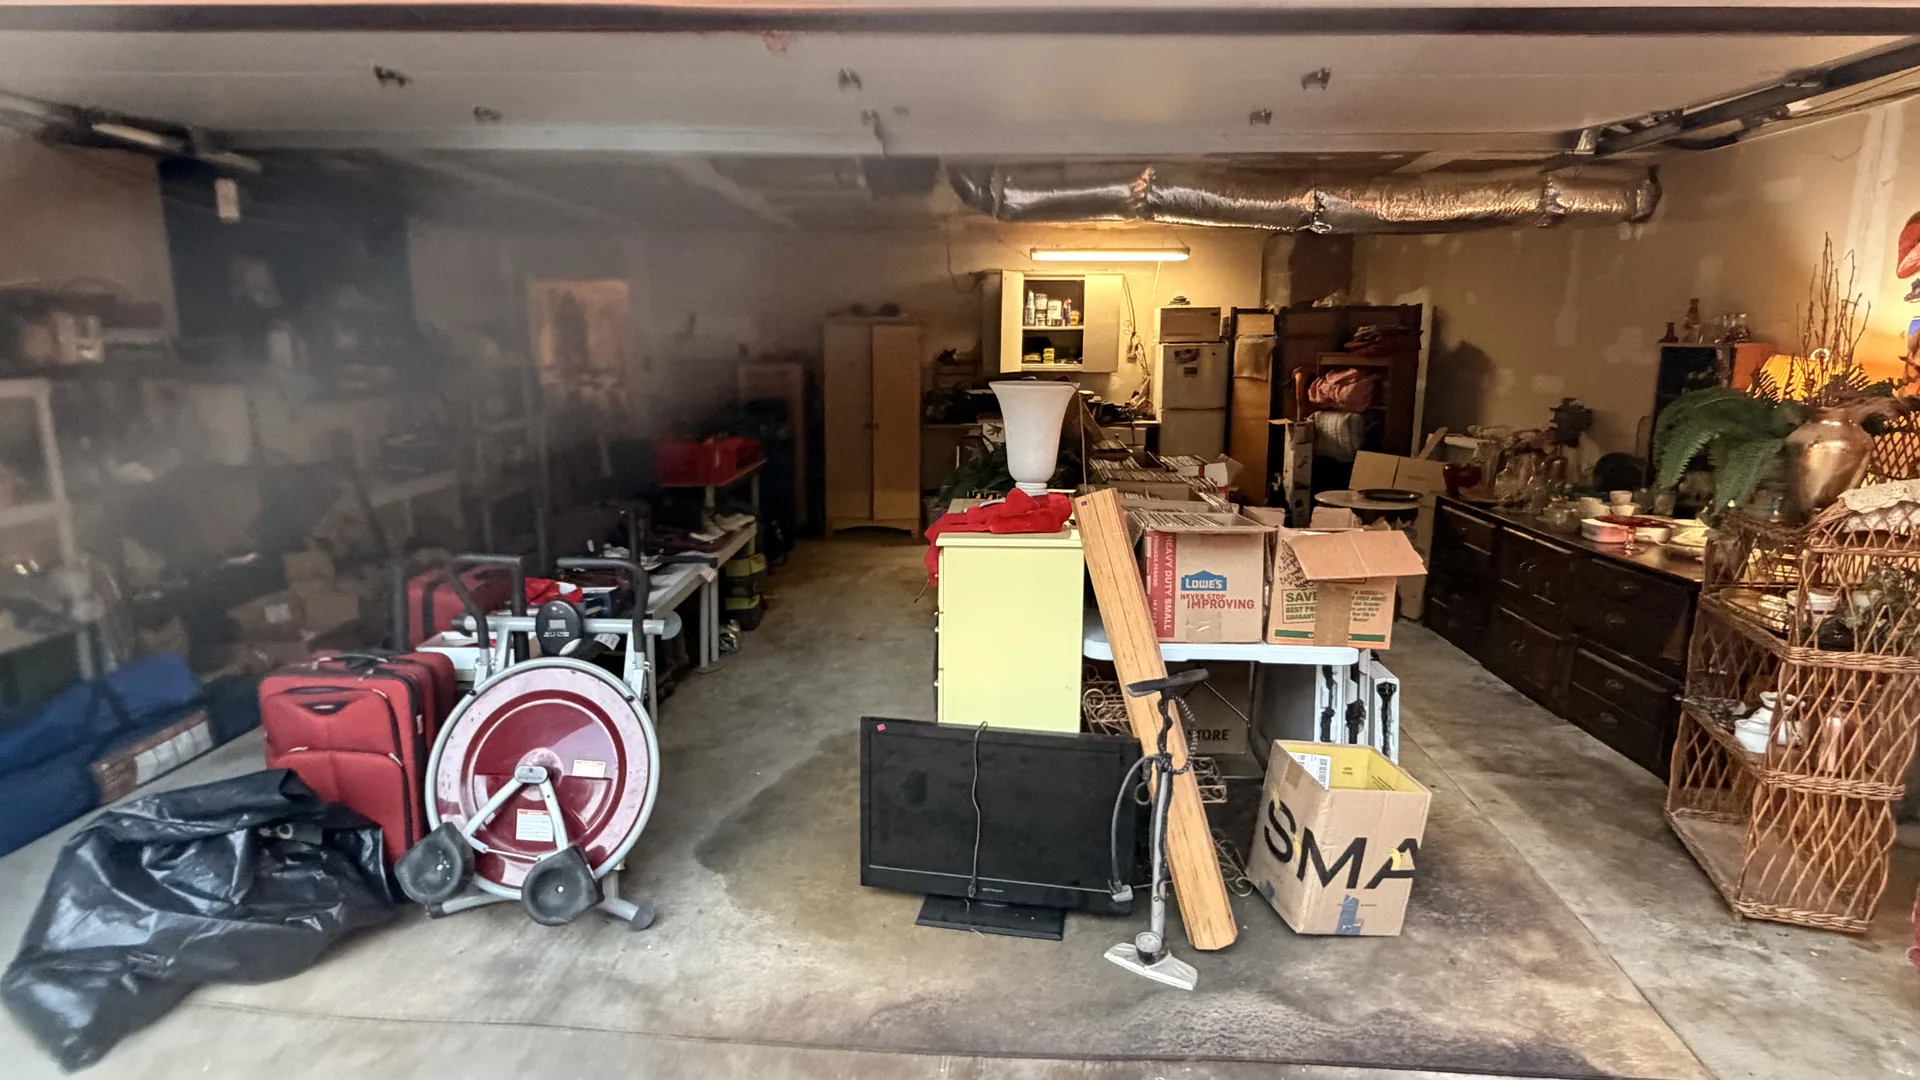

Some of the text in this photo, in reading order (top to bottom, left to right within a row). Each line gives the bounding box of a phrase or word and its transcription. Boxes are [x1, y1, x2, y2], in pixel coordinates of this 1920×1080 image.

[1163, 535, 1173, 631] HEAVY DUTY SMALL
[1187, 599, 1255, 610] IMPROVING
[1264, 799, 1421, 890] SMA
